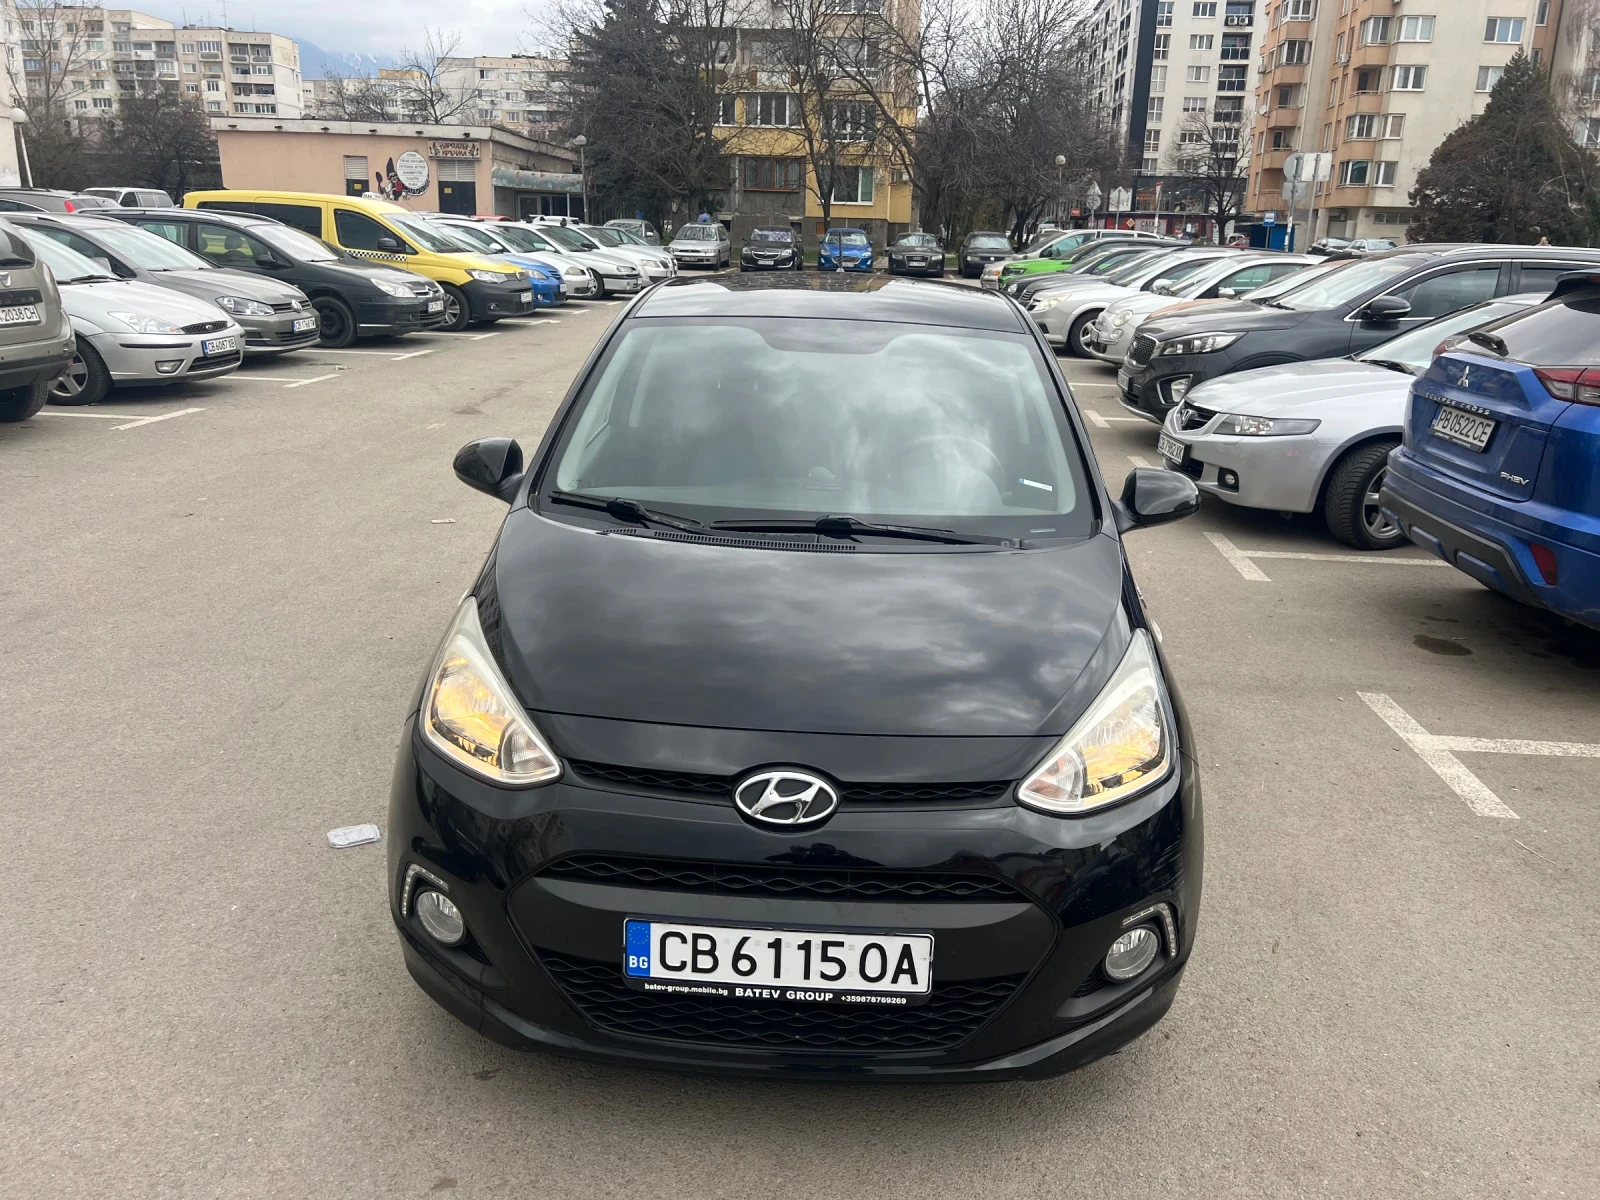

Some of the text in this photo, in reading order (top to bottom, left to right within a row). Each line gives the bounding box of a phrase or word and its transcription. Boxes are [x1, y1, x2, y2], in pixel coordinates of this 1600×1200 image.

[2, 308, 24, 321] 2038
[24, 307, 37, 319] CH
[208, 342, 215, 352] CB
[1425, 392, 1491, 415] ECLIPSE CROSS
[1436, 410, 1492, 443] PB 0522 CE
[1500, 471, 1530, 485] PHEV
[629, 955, 648, 969] BG
[659, 931, 719, 974] CB
[731, 936, 847, 982] 6115
[644, 983, 907, 1005] batev-group.mobile.bg BATEV GROUP +359878769269
